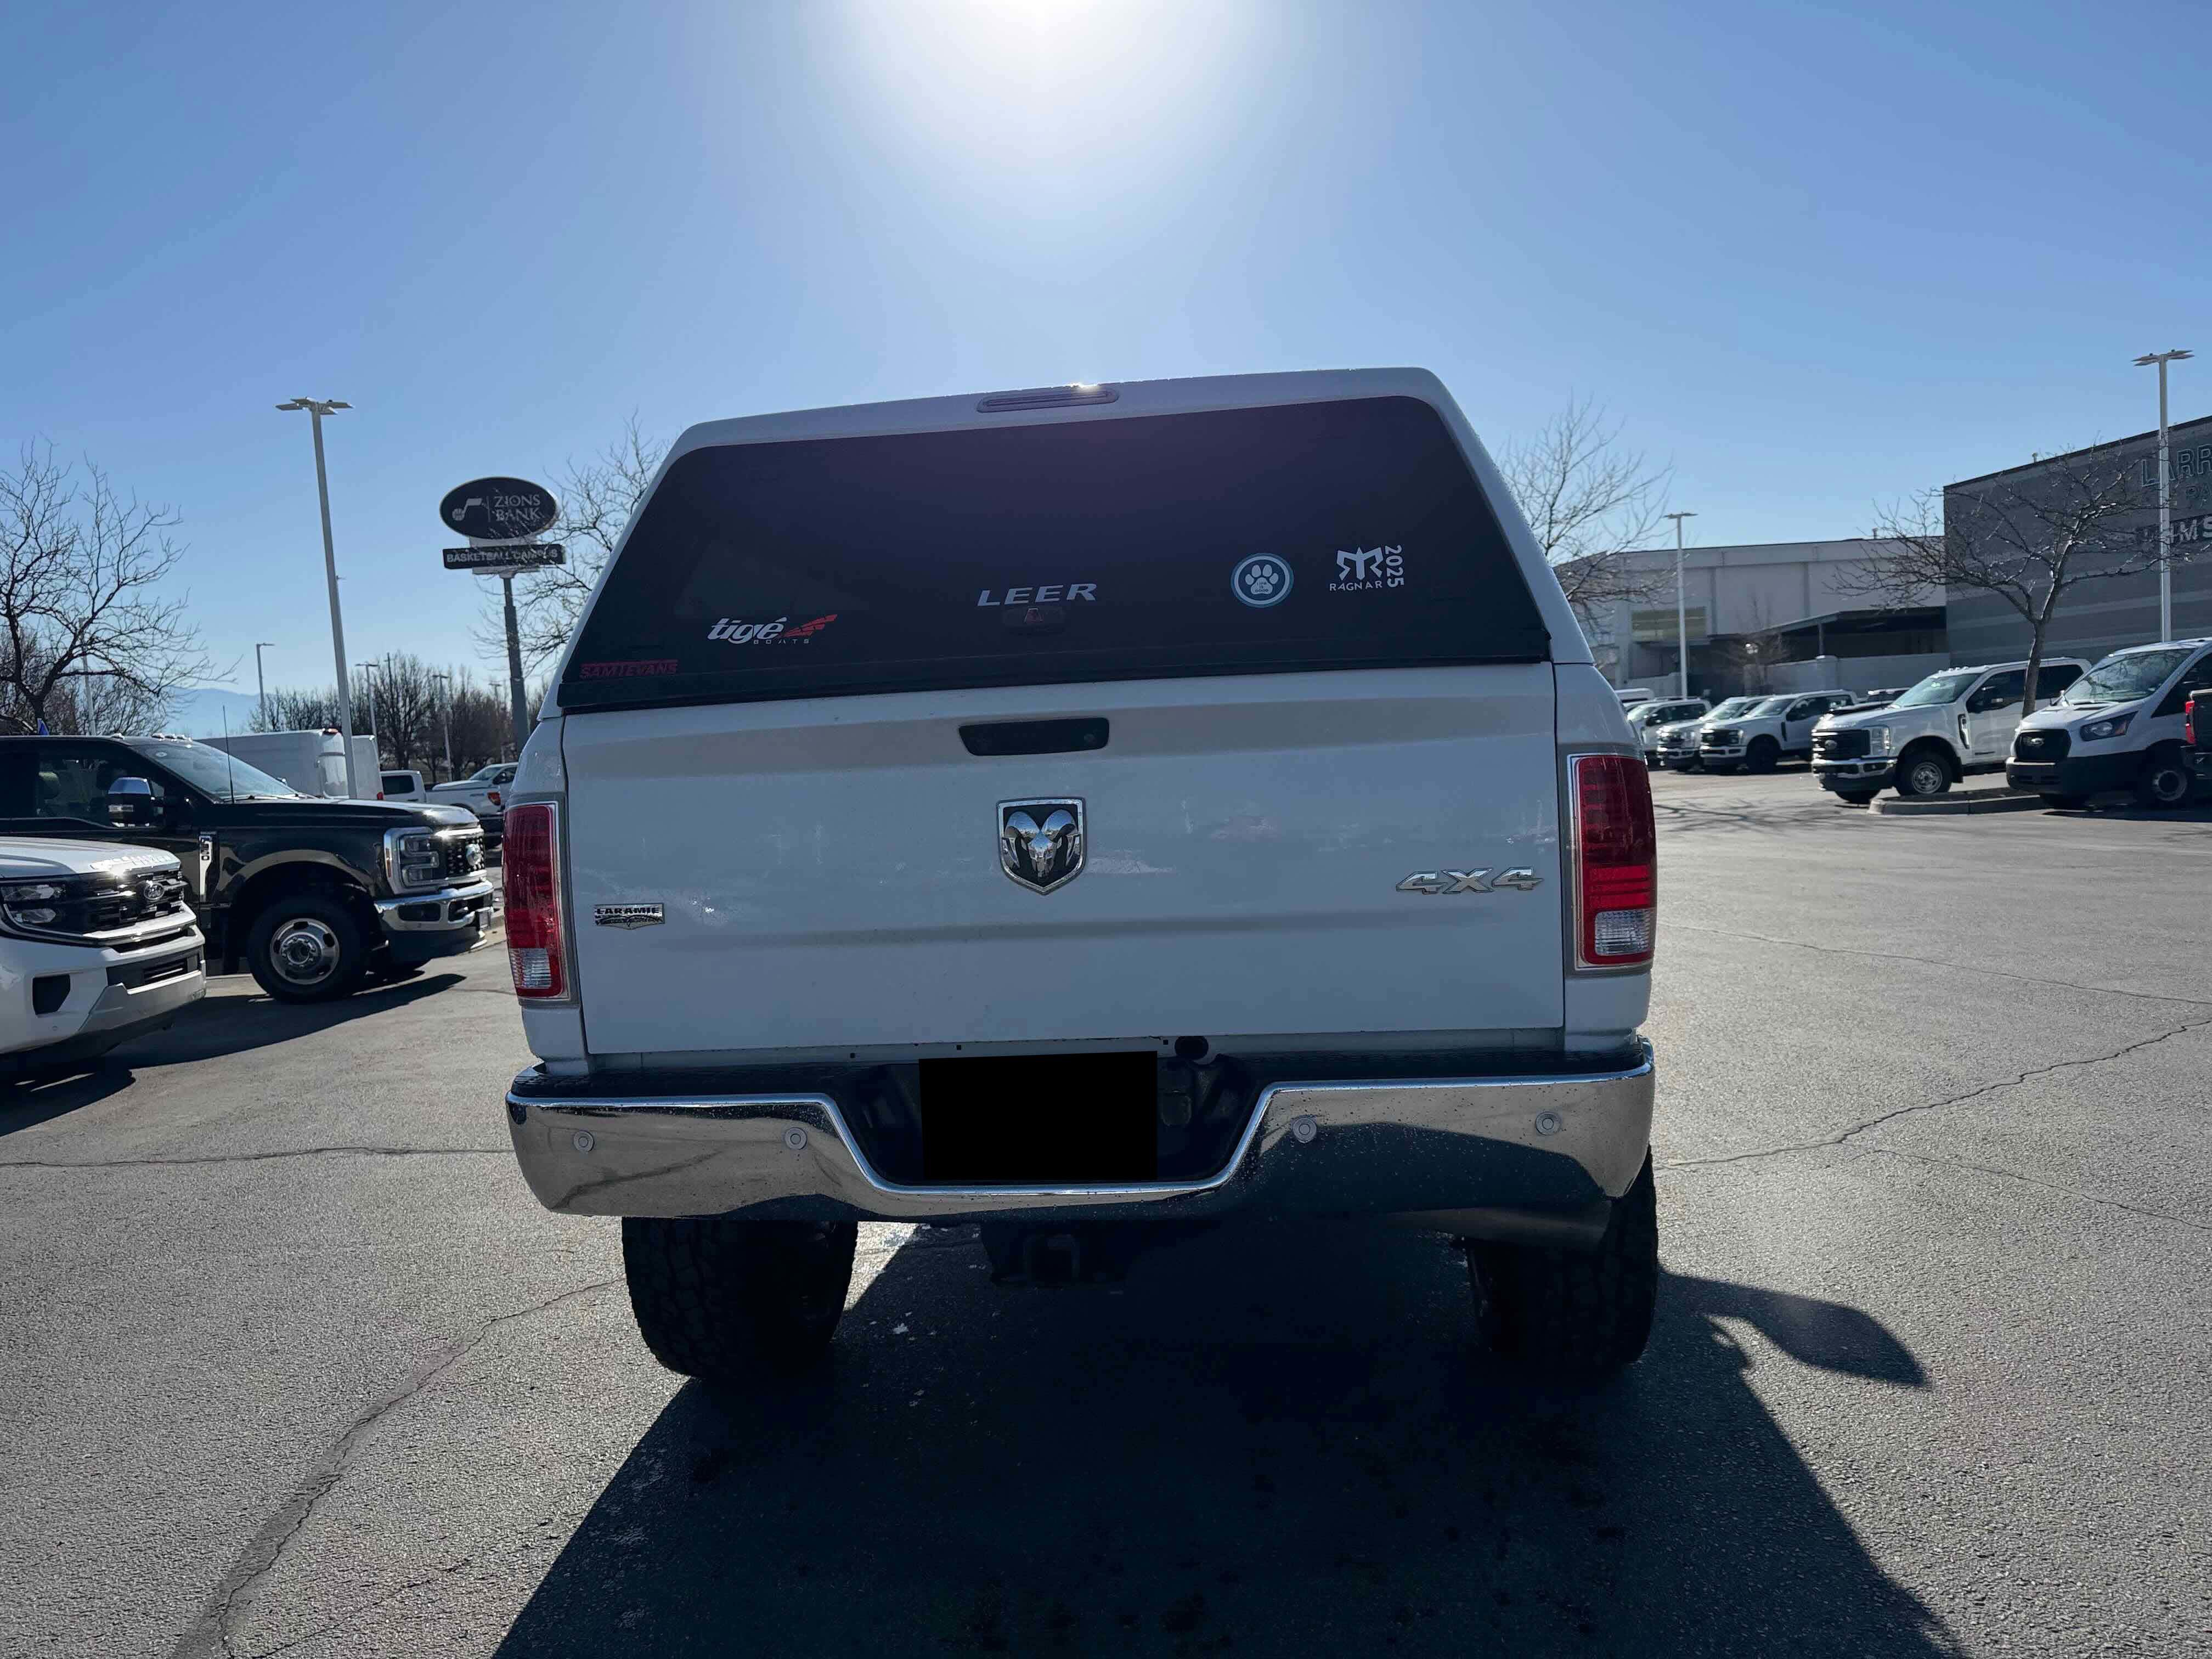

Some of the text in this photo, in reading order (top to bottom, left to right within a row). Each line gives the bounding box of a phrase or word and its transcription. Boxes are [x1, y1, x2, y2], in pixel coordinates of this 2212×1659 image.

[494, 495, 540, 507] ZIONS
[496, 507, 540, 521] BANK
[447, 548, 558, 562] BASKETBALL CAMPS
[1385, 544, 1404, 588] 2025
[977, 583, 1097, 606] LEER
[1329, 580, 1383, 592] RAGNAR
[707, 617, 787, 644] tigé
[1396, 866, 1544, 895] 4X4
